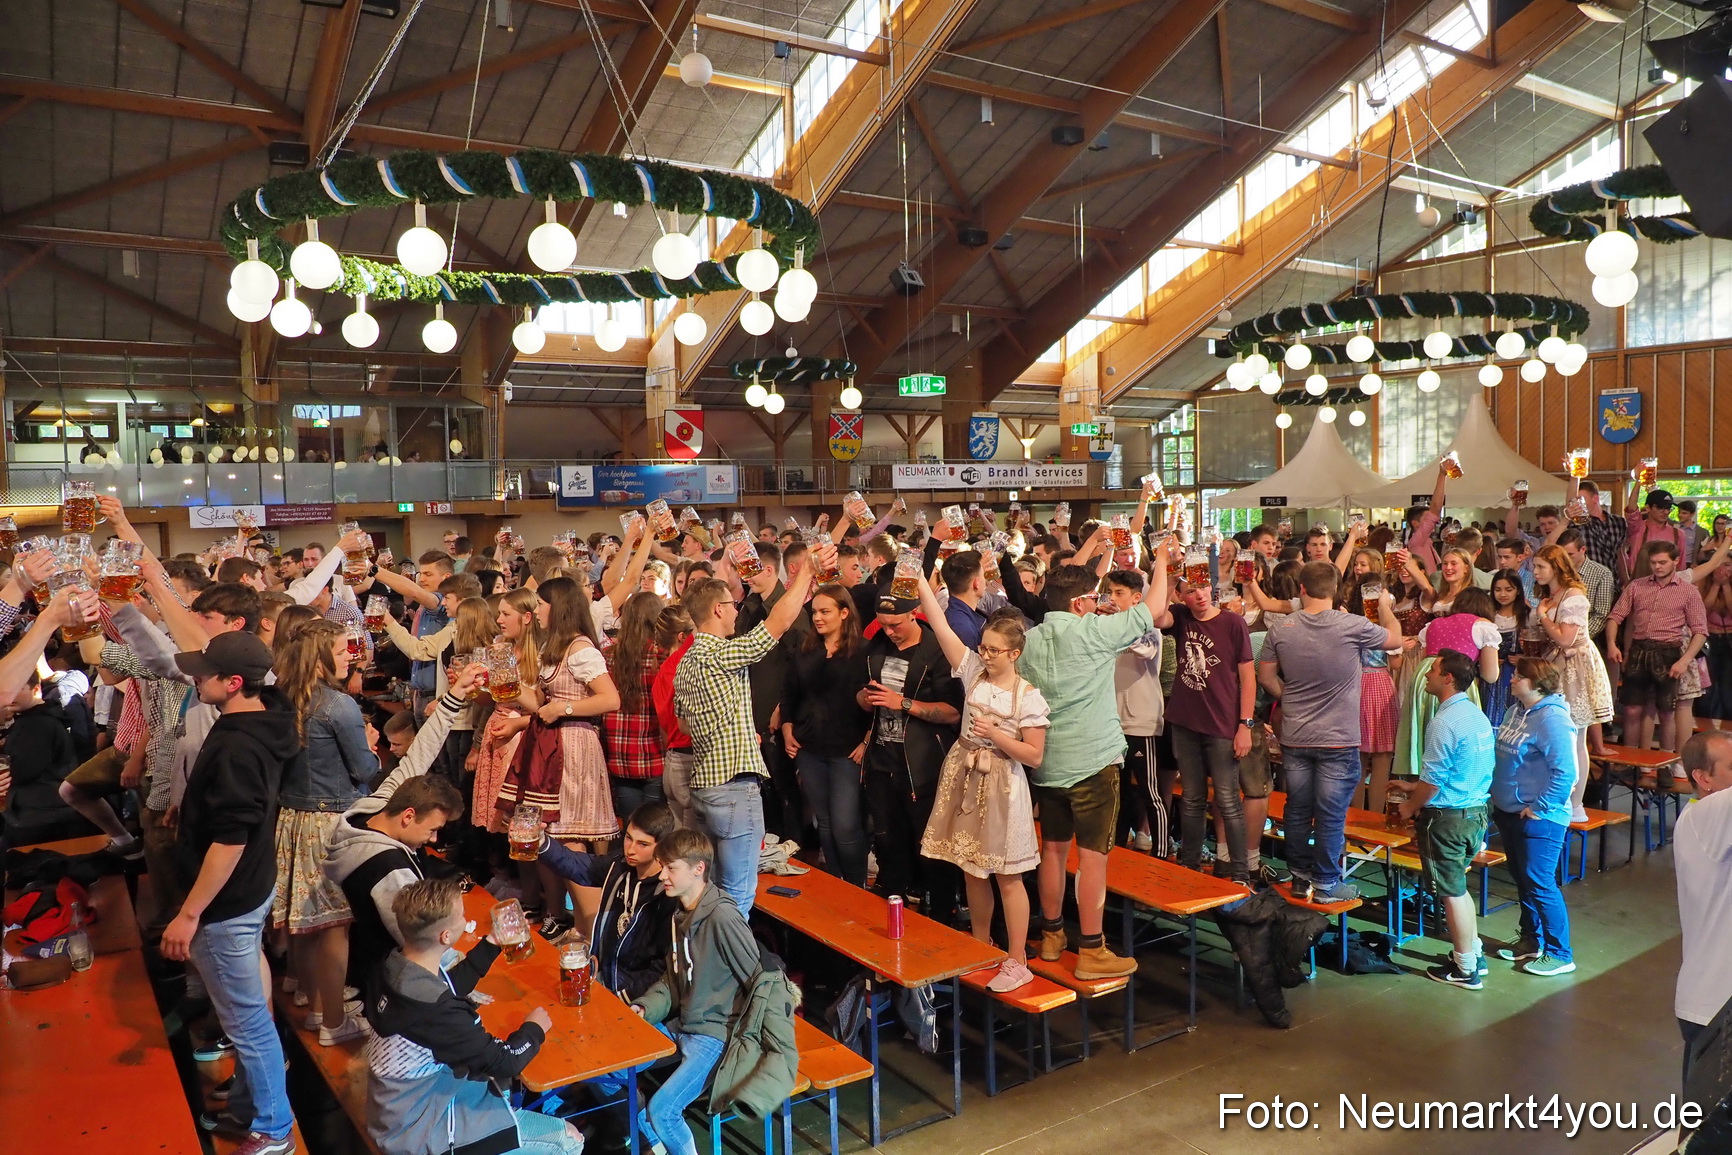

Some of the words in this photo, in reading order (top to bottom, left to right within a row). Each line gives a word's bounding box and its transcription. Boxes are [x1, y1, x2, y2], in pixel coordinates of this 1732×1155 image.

[898, 466, 946, 476] NEUMARKT
[988, 467, 1028, 477] Brandl
[1035, 467, 1083, 476] services
[1199, 634, 1214, 649] CLUB
